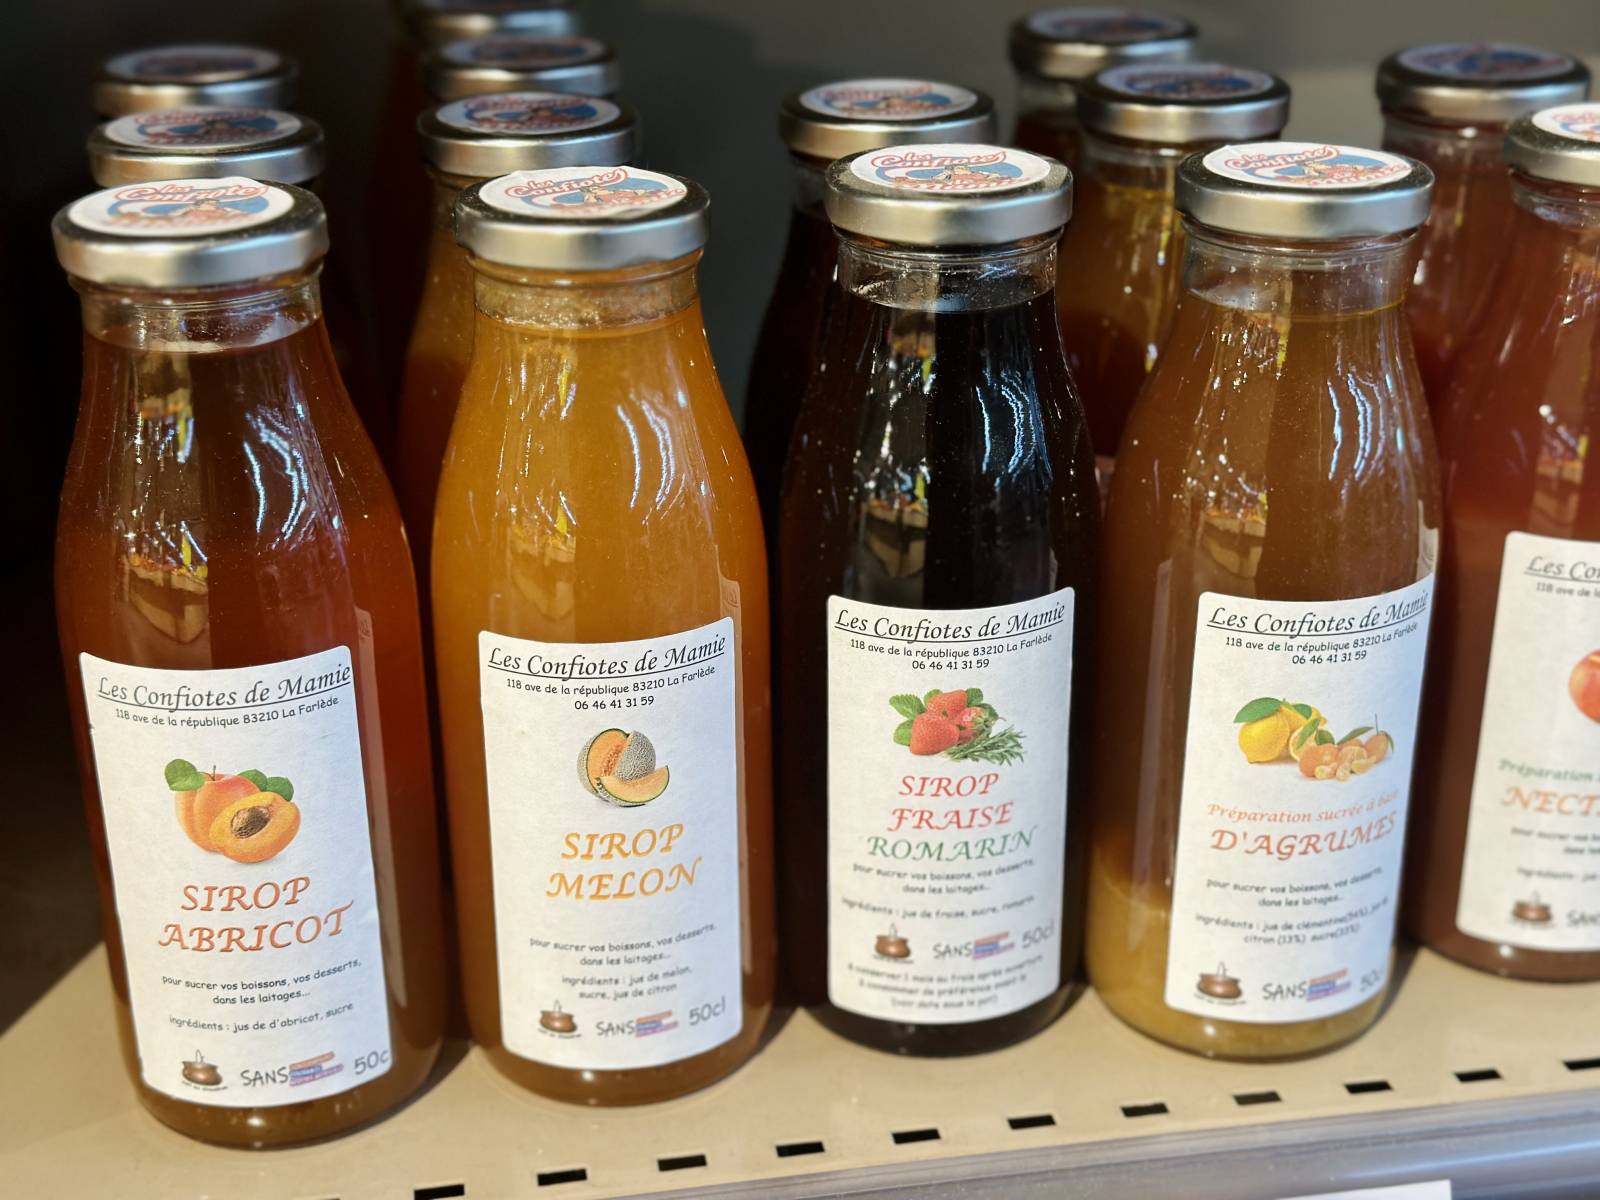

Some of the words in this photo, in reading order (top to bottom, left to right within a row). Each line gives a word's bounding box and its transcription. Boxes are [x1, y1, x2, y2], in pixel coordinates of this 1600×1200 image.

[1526, 556, 1564, 575] Les
[1569, 561, 1600, 580] Co
[1556, 587, 1574, 595] ave
[1577, 588, 1590, 596] de
[835, 610, 867, 631] Les
[874, 617, 971, 643] Confiotes
[978, 615, 1000, 636] de
[1006, 602, 1065, 634] Mamie
[1208, 607, 1248, 628] Les
[1254, 613, 1355, 638] Confiotes
[1359, 607, 1380, 628] de
[851, 639, 865, 649] 118
[868, 644, 884, 653] ave
[888, 646, 900, 655] de
[903, 647, 912, 656] la
[915, 647, 969, 660] république
[973, 645, 1003, 656] 83210
[1006, 643, 1018, 652] La
[1020, 633, 1052, 650] Farlède
[1226, 637, 1242, 647] 118
[1246, 641, 1263, 649] ave
[1267, 641, 1280, 651] de
[1284, 642, 1293, 651] la
[1297, 641, 1349, 652] république
[1353, 635, 1381, 648] 83210
[1382, 633, 1391, 642] La
[489, 648, 520, 669] Les
[527, 655, 627, 681] Confiotes
[635, 650, 657, 672] de
[664, 634, 726, 667] Mamie
[912, 660, 925, 669] 06
[929, 661, 942, 670] 46
[947, 660, 957, 670] 41
[962, 660, 973, 669] 31
[976, 659, 989, 668] 59
[1292, 655, 1305, 664] 06
[1310, 655, 1323, 664] 46
[1327, 653, 1338, 663] 41
[1341, 652, 1352, 661] 31
[1355, 650, 1367, 660] 59
[99, 677, 128, 700] Les
[134, 686, 237, 712] Confiotes
[245, 681, 270, 701] de
[278, 664, 351, 699] Mamie
[507, 679, 521, 689] 118
[525, 684, 541, 693] ave
[545, 684, 557, 693] de
[561, 686, 570, 694] la
[573, 684, 629, 697] république
[633, 679, 664, 692] 83210
[668, 677, 679, 685] La
[682, 666, 715, 683] Farlède
[116, 708, 130, 720] 118
[132, 715, 149, 724] ave
[152, 715, 165, 725] de
[168, 717, 177, 726] la
[180, 716, 239, 728] république
[243, 710, 279, 723] 83210
[282, 709, 296, 718] La
[299, 696, 338, 715] Farlède
[574, 700, 588, 709] 06
[592, 700, 606, 709] 46
[610, 699, 622, 709] 41
[626, 697, 637, 707] 31
[640, 696, 654, 705] 59
[899, 773, 999, 797] SIROP
[1208, 803, 1311, 824] Préparation
[1316, 803, 1363, 821] sucrée
[1501, 785, 1600, 817] NECT
[888, 802, 1014, 831] FRAISE
[561, 824, 684, 860] SIROP
[867, 825, 1038, 862] ROMARIN
[1210, 810, 1397, 861] D'AGRUMES
[546, 857, 702, 900] MELON
[1206, 878, 1229, 888] pour
[1233, 883, 1266, 893] sucrer
[1270, 885, 1286, 893] vos
[181, 876, 310, 912] SIROP
[1259, 898, 1281, 907] dans
[1285, 897, 1299, 906] les
[158, 900, 354, 952] ABRICOT
[530, 937, 550, 948] pour
[554, 941, 586, 952] sucrer
[590, 944, 605, 952] vos
[609, 940, 654, 952] boissons,
[657, 937, 672, 946] vos
[933, 942, 973, 959] SANS
[580, 956, 603, 966] dans
[606, 955, 620, 965] les
[162, 976, 182, 986] pour
[185, 980, 218, 989] sucrer
[221, 982, 238, 990] vos
[241, 978, 290, 990] boissons,
[293, 974, 310, 984] vos
[313, 958, 362, 979] desserts,
[561, 975, 619, 987] ingrédients
[629, 974, 644, 986] jus
[647, 972, 659, 981] de
[213, 995, 236, 1004] dans
[240, 994, 256, 1003] les
[579, 989, 611, 999] sucre,
[613, 989, 628, 1000] jus
[632, 987, 643, 997] de
[647, 982, 677, 996] citron
[1262, 982, 1306, 1002] SANS
[170, 1016, 223, 1031] ingrédients
[232, 1022, 249, 1033] jus
[252, 1020, 266, 1030] de
[270, 1013, 323, 1029] d'abricot,
[326, 1003, 354, 1018] sucre
[596, 1020, 635, 1037] SANS
[689, 996, 725, 1026] 50cl
[240, 1067, 288, 1087] SANS
